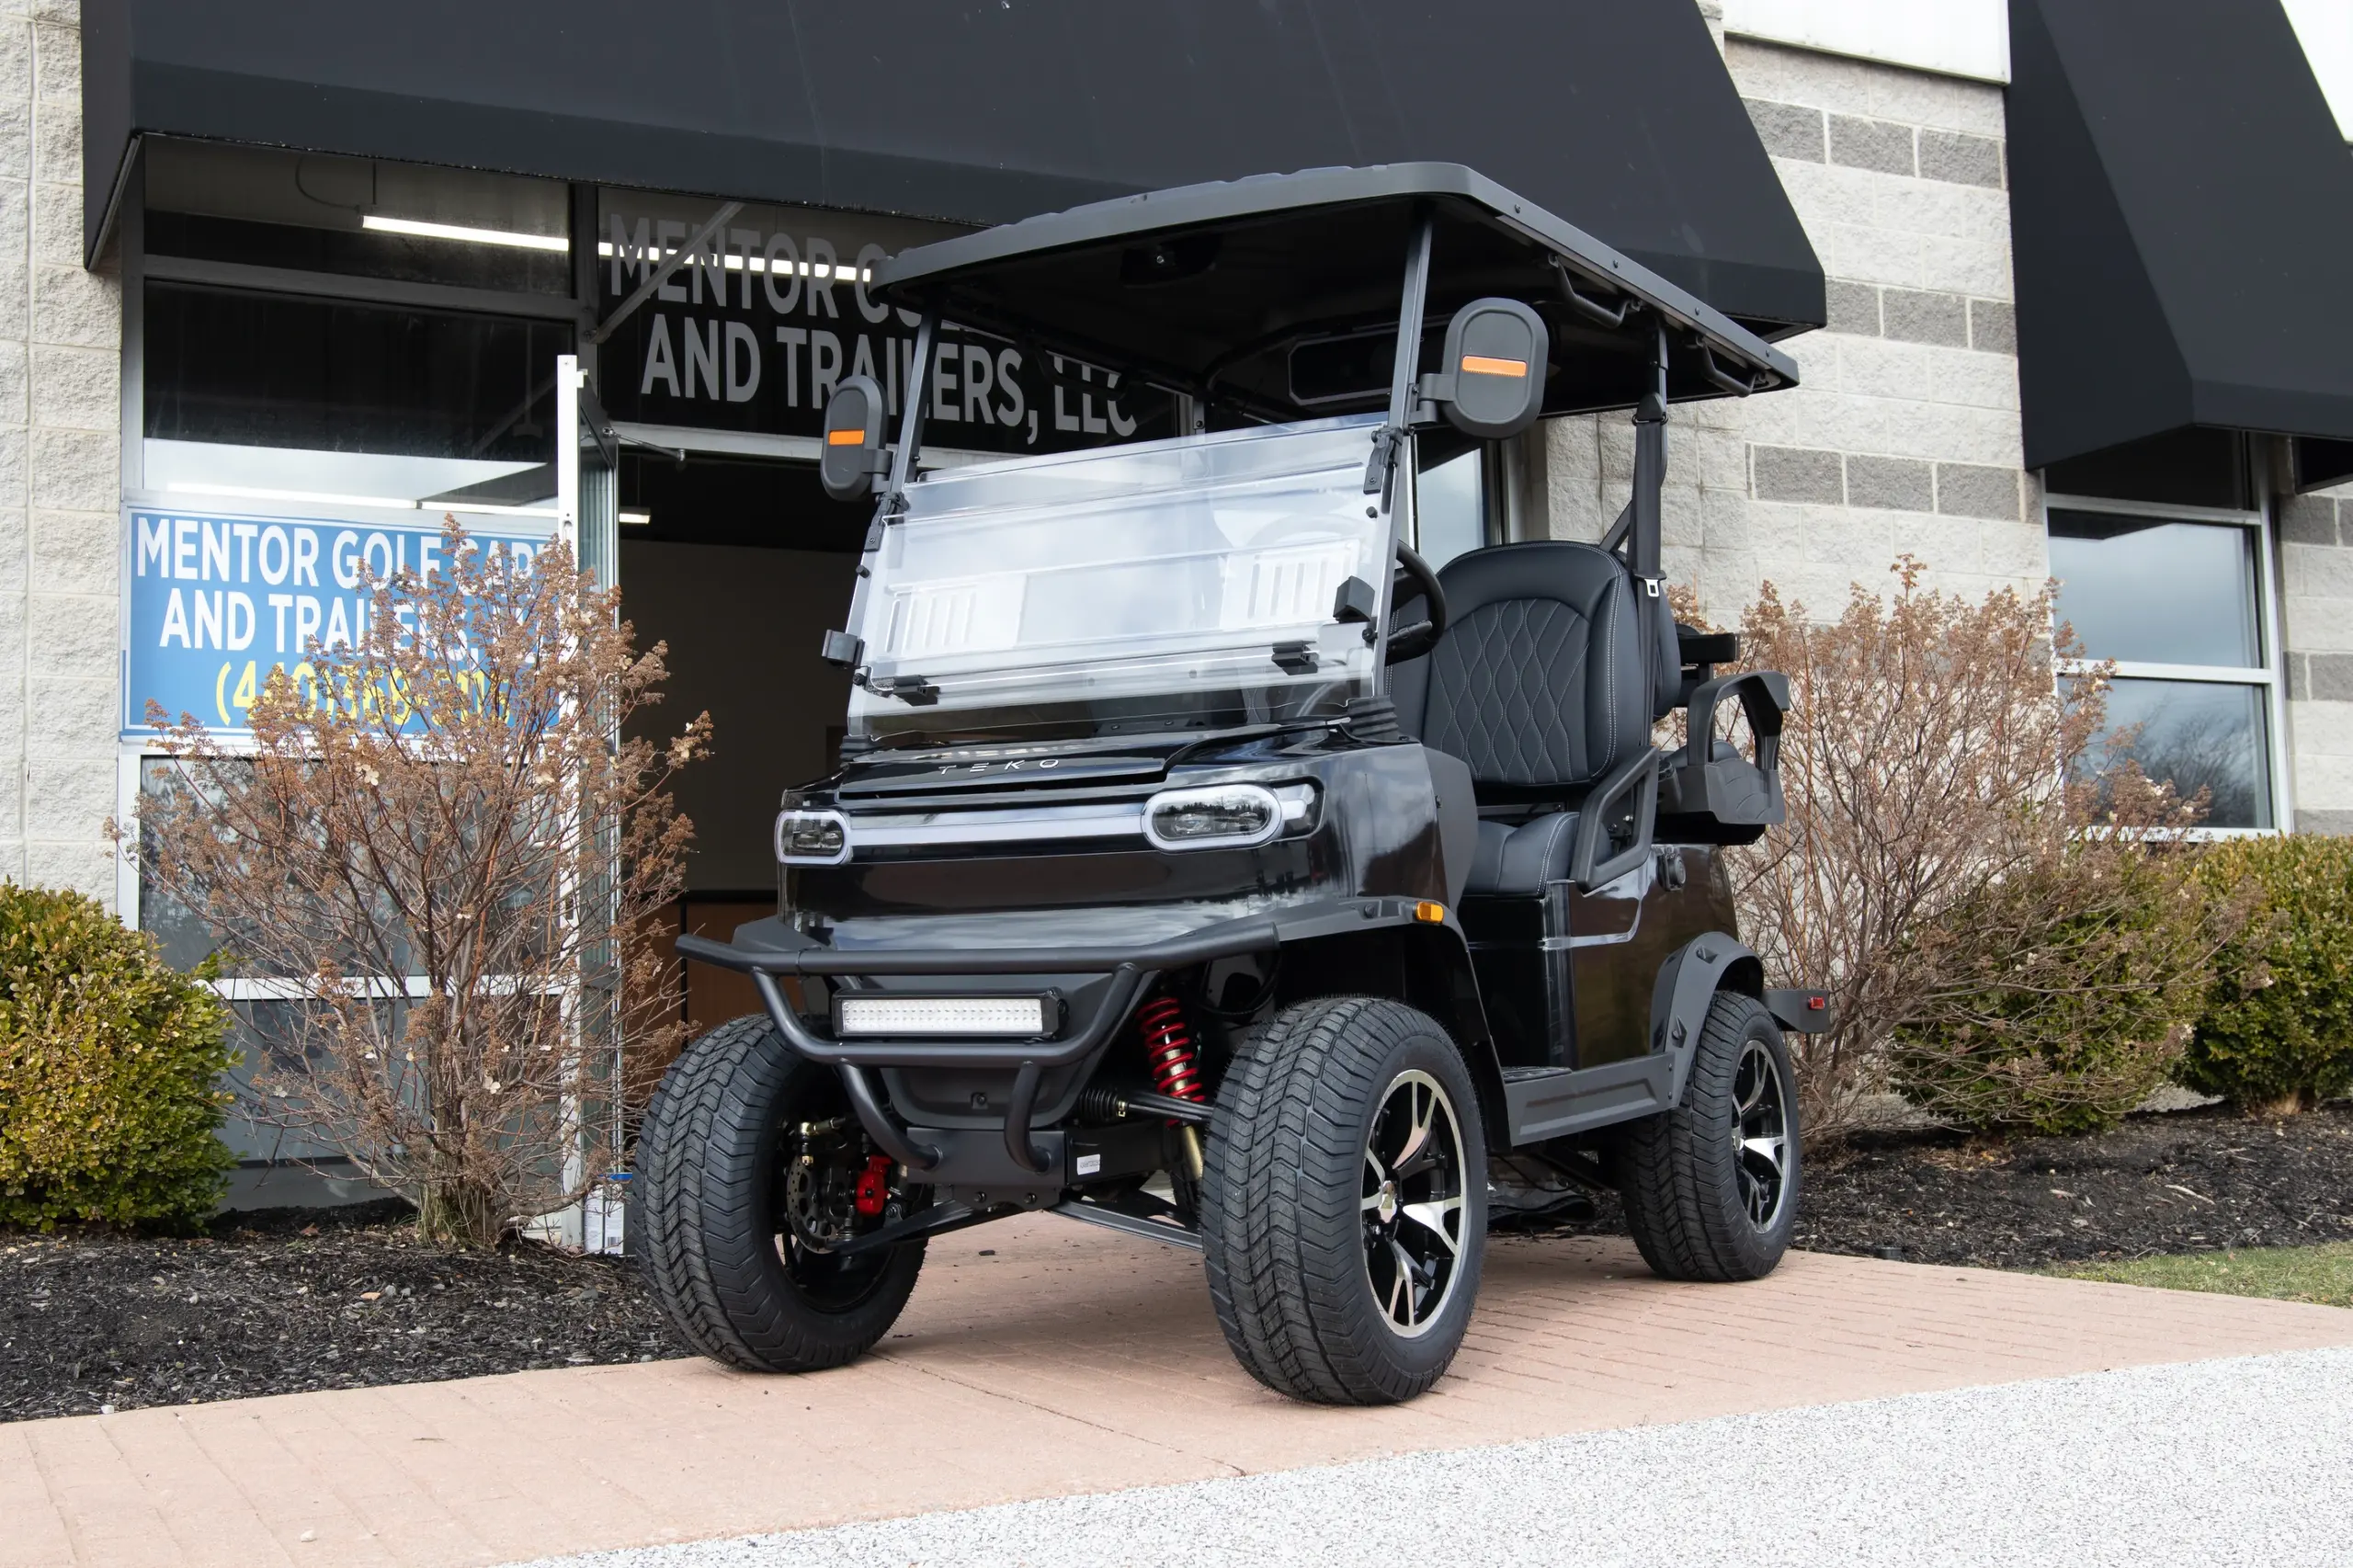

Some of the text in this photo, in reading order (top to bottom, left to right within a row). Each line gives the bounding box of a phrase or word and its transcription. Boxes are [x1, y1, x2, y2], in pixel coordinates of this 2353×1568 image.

[610, 213, 840, 320] MENTOR
[641, 313, 761, 403] AND
[1052, 354, 1137, 437] LLC
[137, 517, 549, 599] MENTOR GOLF CAR
[159, 588, 256, 651] AND
[938, 758, 1059, 775] TEKO
